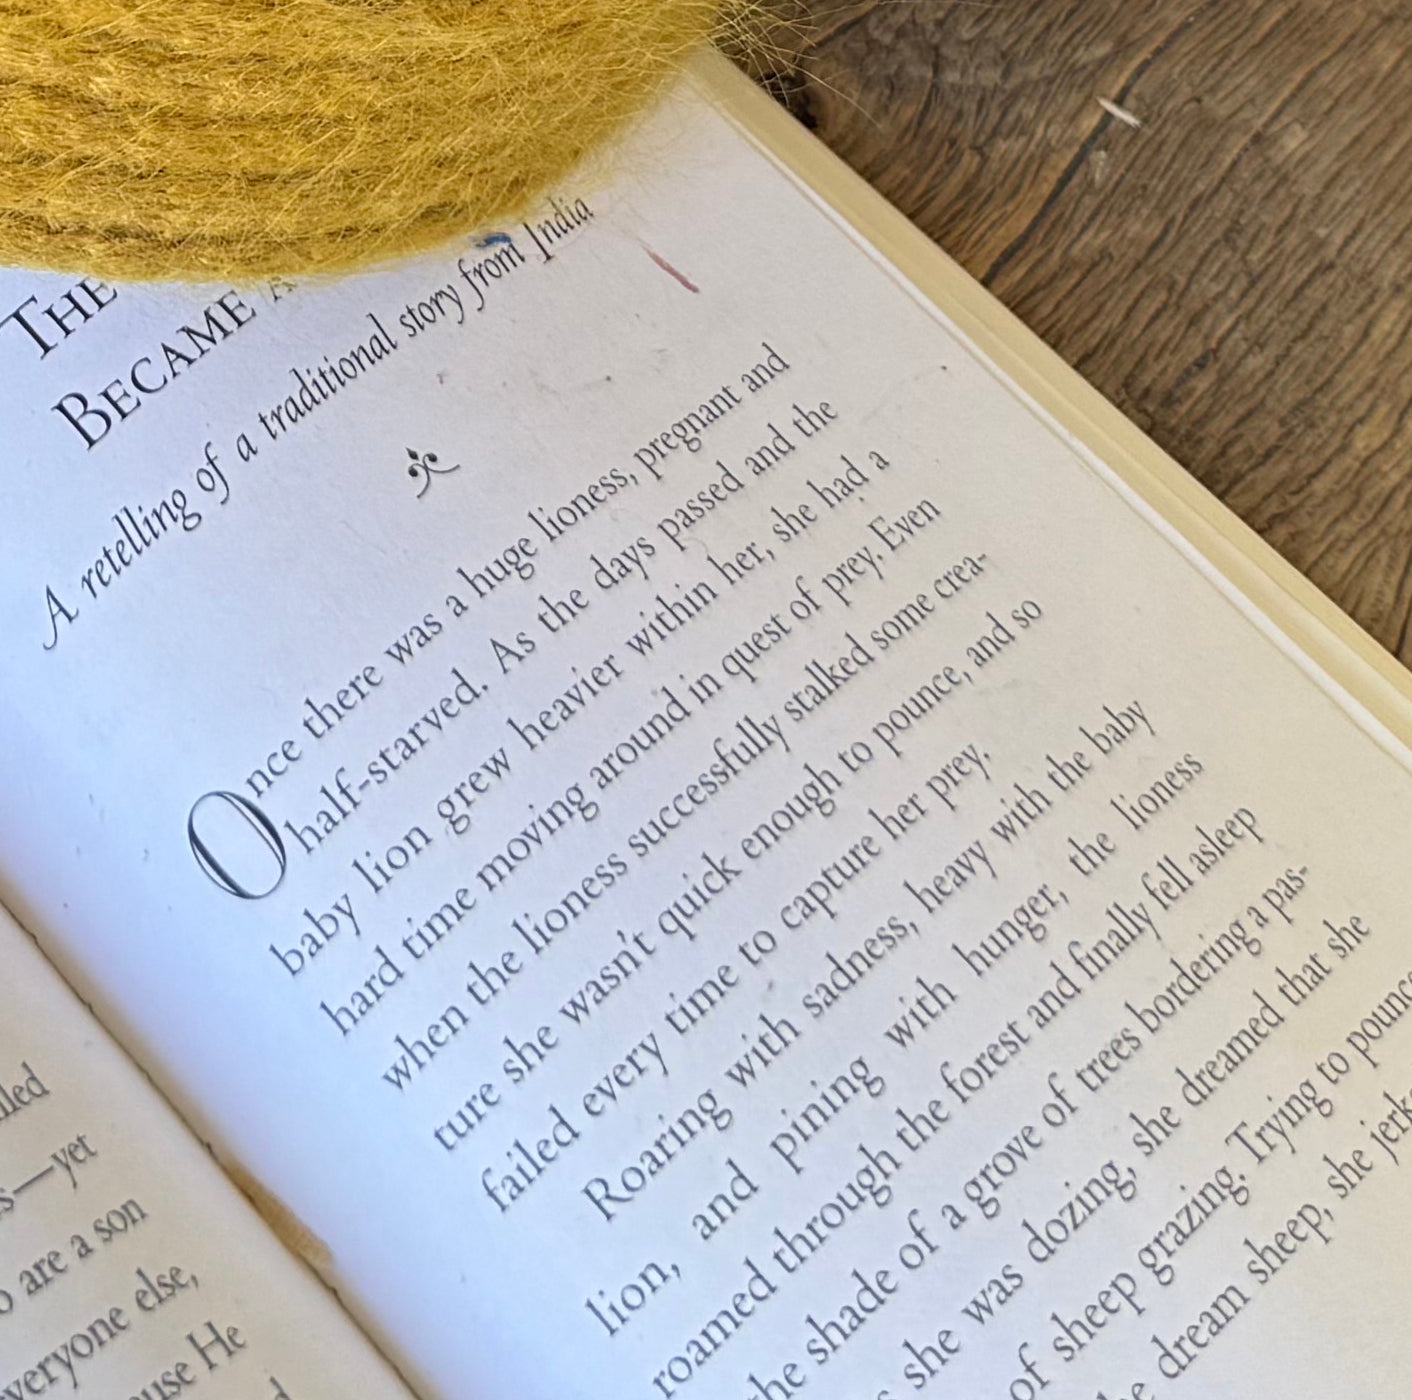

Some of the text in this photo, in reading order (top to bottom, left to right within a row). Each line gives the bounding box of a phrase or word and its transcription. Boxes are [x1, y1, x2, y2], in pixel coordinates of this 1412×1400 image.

[43, 197, 594, 651] A retelling of a traditional story from India
[51, 289, 258, 450] BECAME
[187, 340, 791, 899] Once there was a huge lioness, pregnant and
[268, 449, 891, 977] baby lion grew heavier within her, she had a
[381, 552, 988, 1091] when the lioness successfully stalked some crea-
[581, 699, 1156, 1222] Roaring with sadness, heavy with the baby
[18, 1250, 69, 1297] are
[69, 1233, 95, 1260] a
[92, 1198, 149, 1244] son
[652, 807, 1265, 1400] roamed through the forest and finally fell asleep
